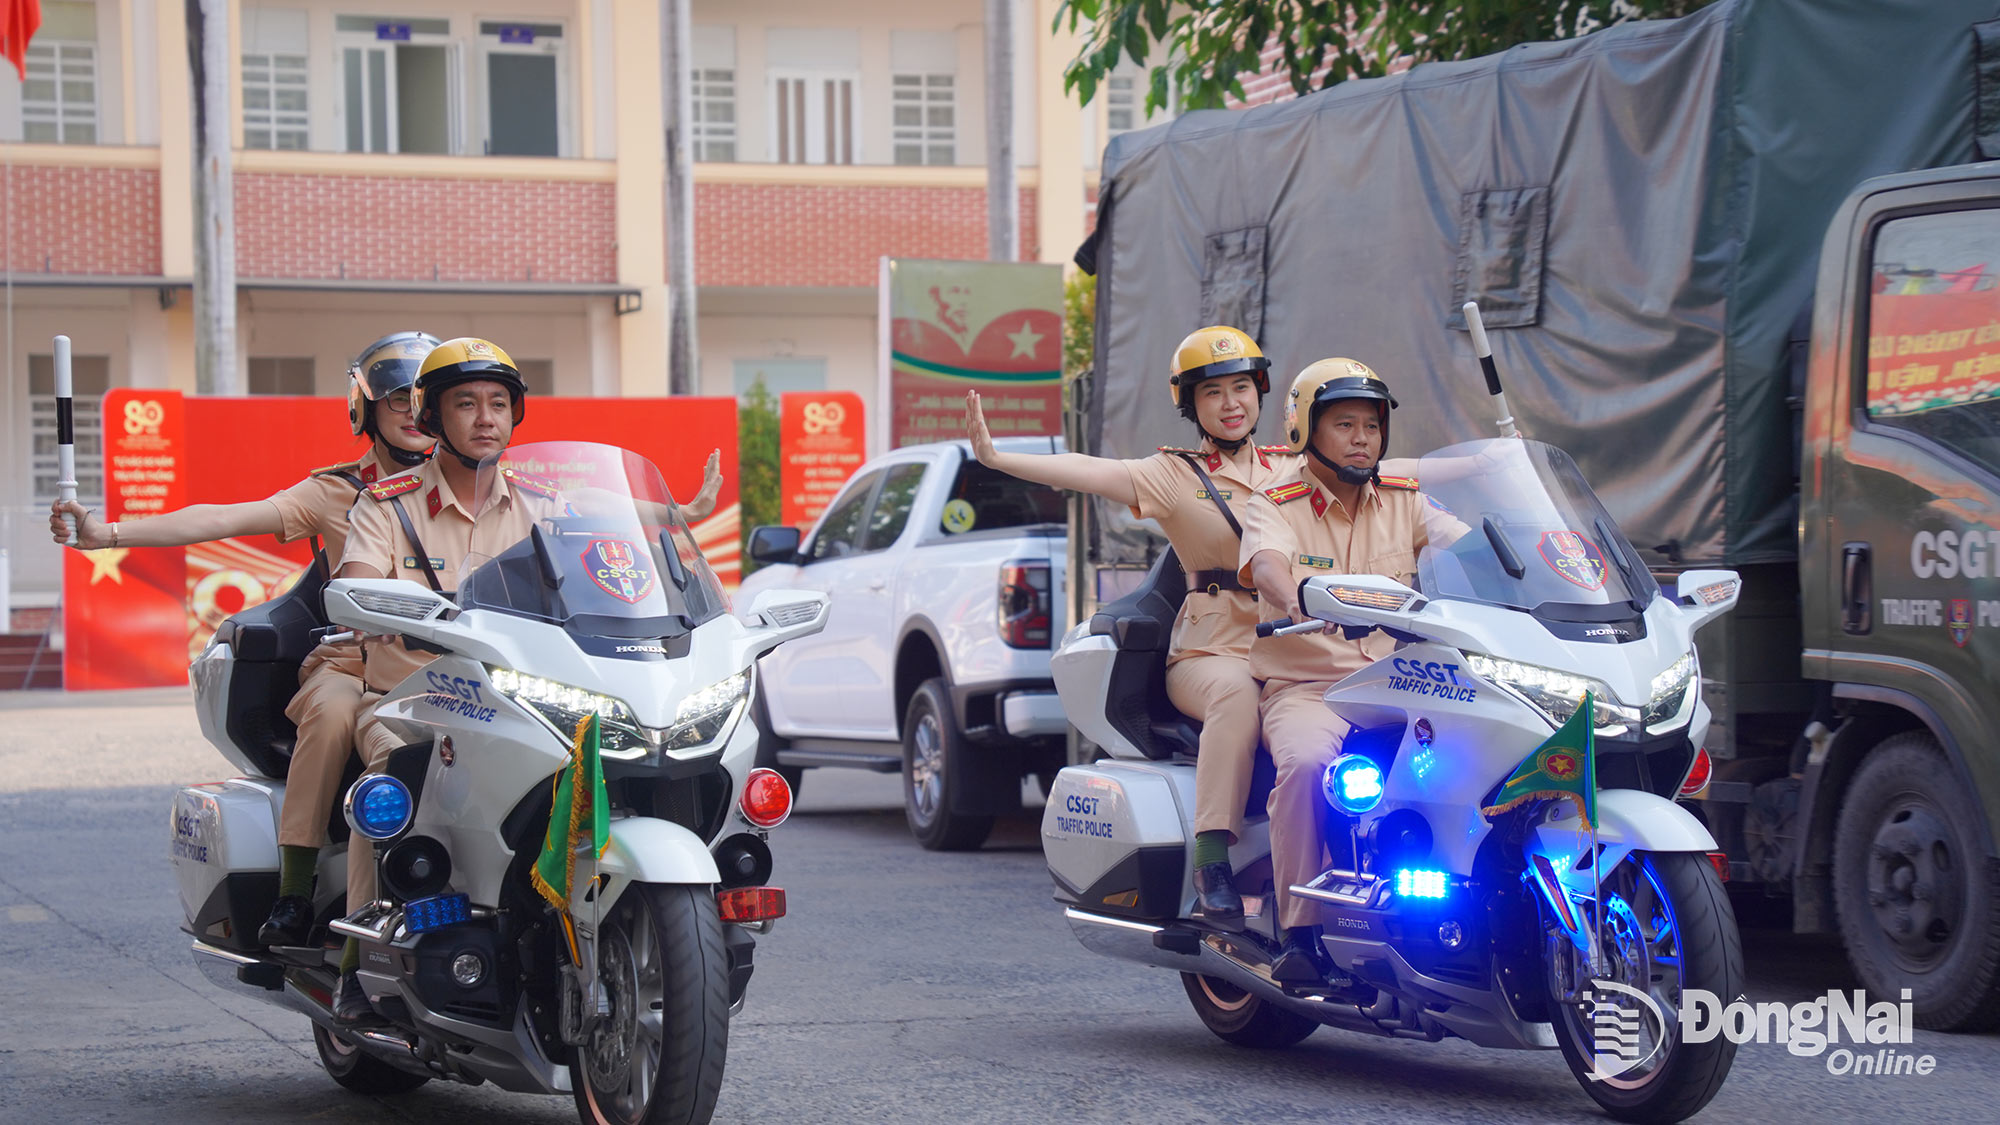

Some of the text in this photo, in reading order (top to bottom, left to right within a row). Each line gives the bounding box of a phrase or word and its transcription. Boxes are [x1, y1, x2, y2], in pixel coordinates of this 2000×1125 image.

[1556, 558, 1600, 568] CSGT
[1911, 529, 2000, 579] CSGT
[597, 568, 648, 579] CSGT
[1881, 598, 1943, 626] TRAFFIC
[1585, 628, 1630, 637] HONDA
[615, 646, 668, 654] HONDA
[1393, 657, 1459, 686] CSGT
[426, 670, 482, 704] CSGT
[1388, 675, 1477, 703] TRAFFIC POLICE
[424, 690, 497, 722] TRAFFIC POLICE
[1067, 794, 1099, 816] CSGT
[178, 815, 200, 838] CSGT
[1057, 816, 1113, 838] TRAFFIC POLICE
[1337, 917, 1371, 930] HONDA
